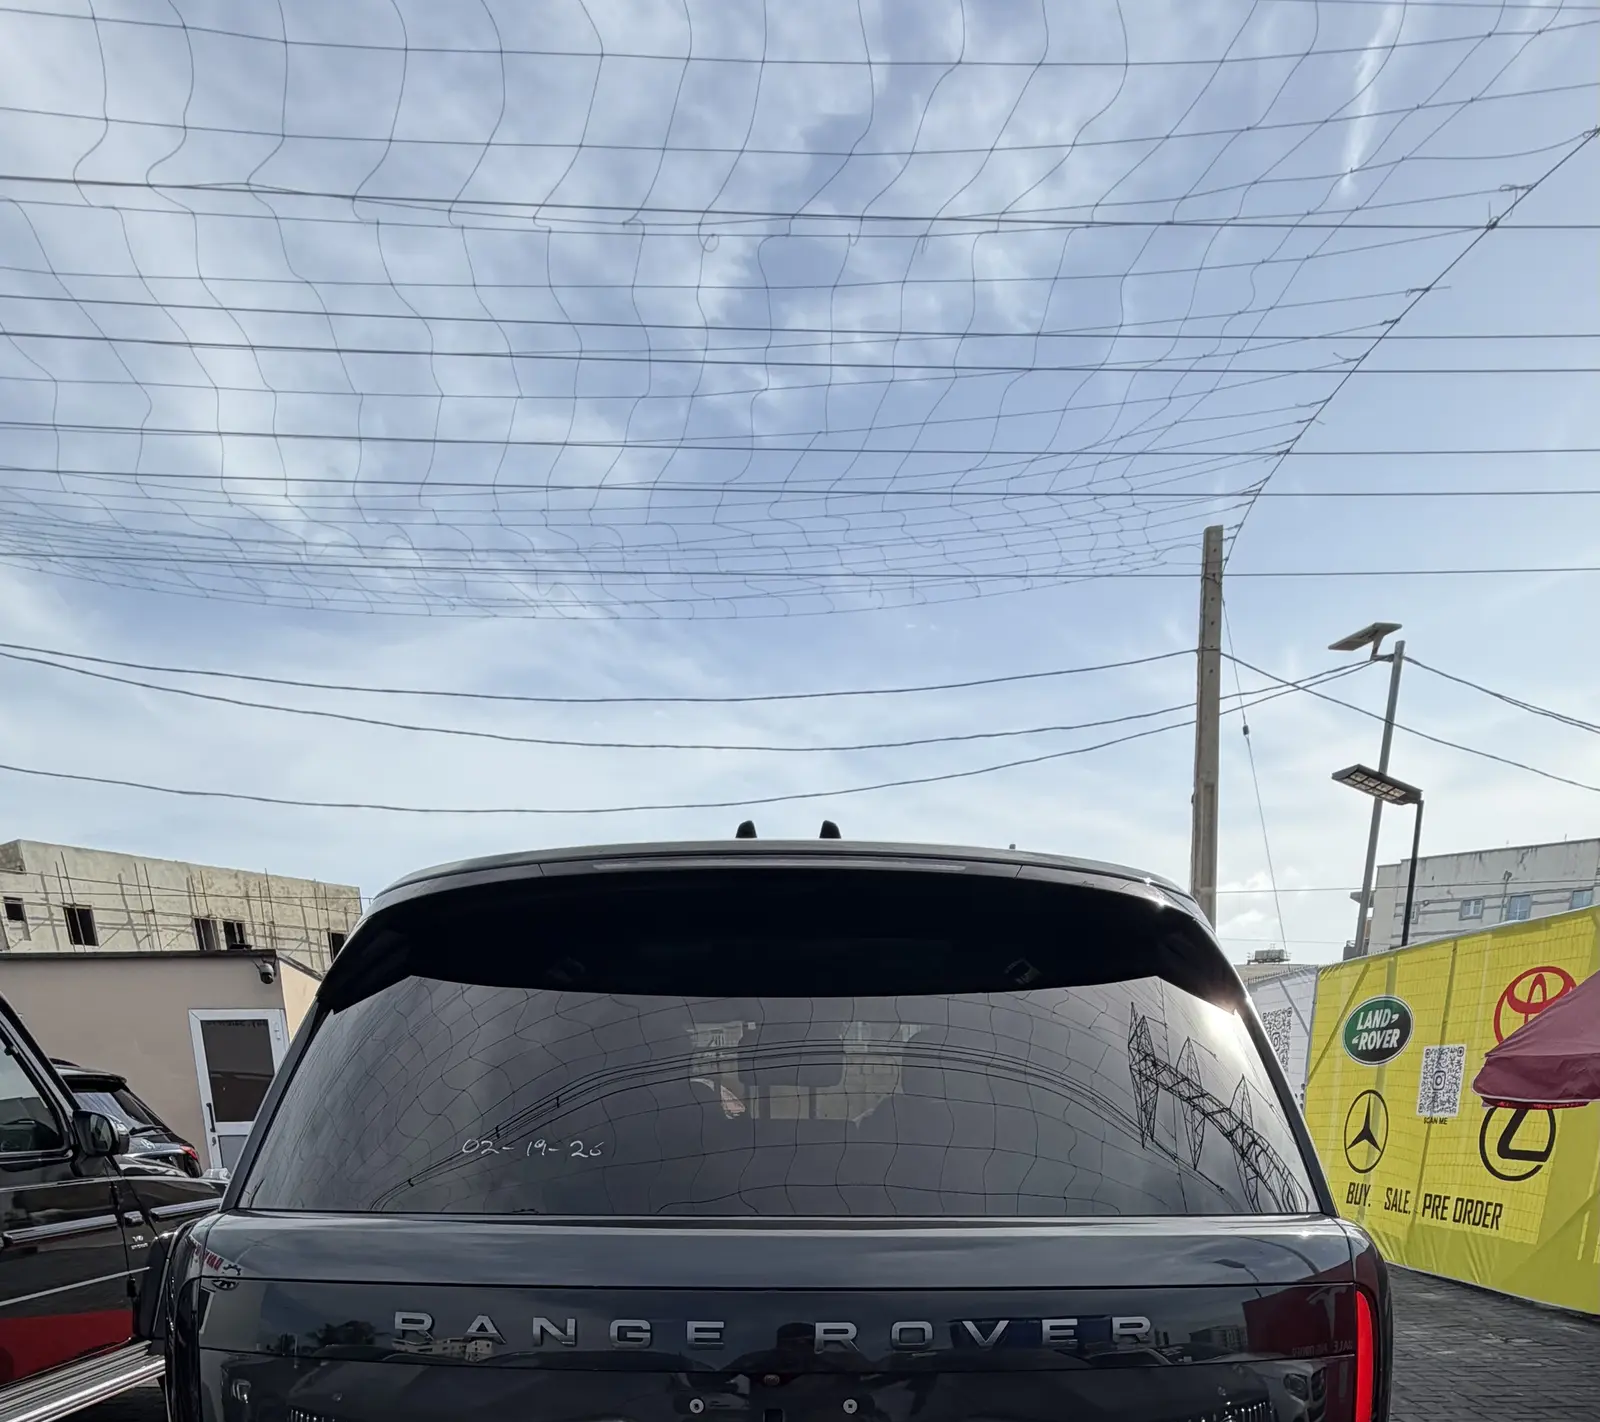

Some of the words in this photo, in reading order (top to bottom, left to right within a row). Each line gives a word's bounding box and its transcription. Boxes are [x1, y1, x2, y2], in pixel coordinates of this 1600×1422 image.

[1356, 1008, 1399, 1031] LAND
[1353, 1028, 1401, 1050] ROVER
[1438, 1118, 1448, 1126] ME
[1346, 1182, 1371, 1207] BUY.
[1384, 1187, 1411, 1215] SALE.
[1421, 1193, 1451, 1221] PRE
[1452, 1197, 1503, 1230] ORDER
[394, 1311, 725, 1349] RANGE
[814, 1316, 1151, 1354] ROVER
